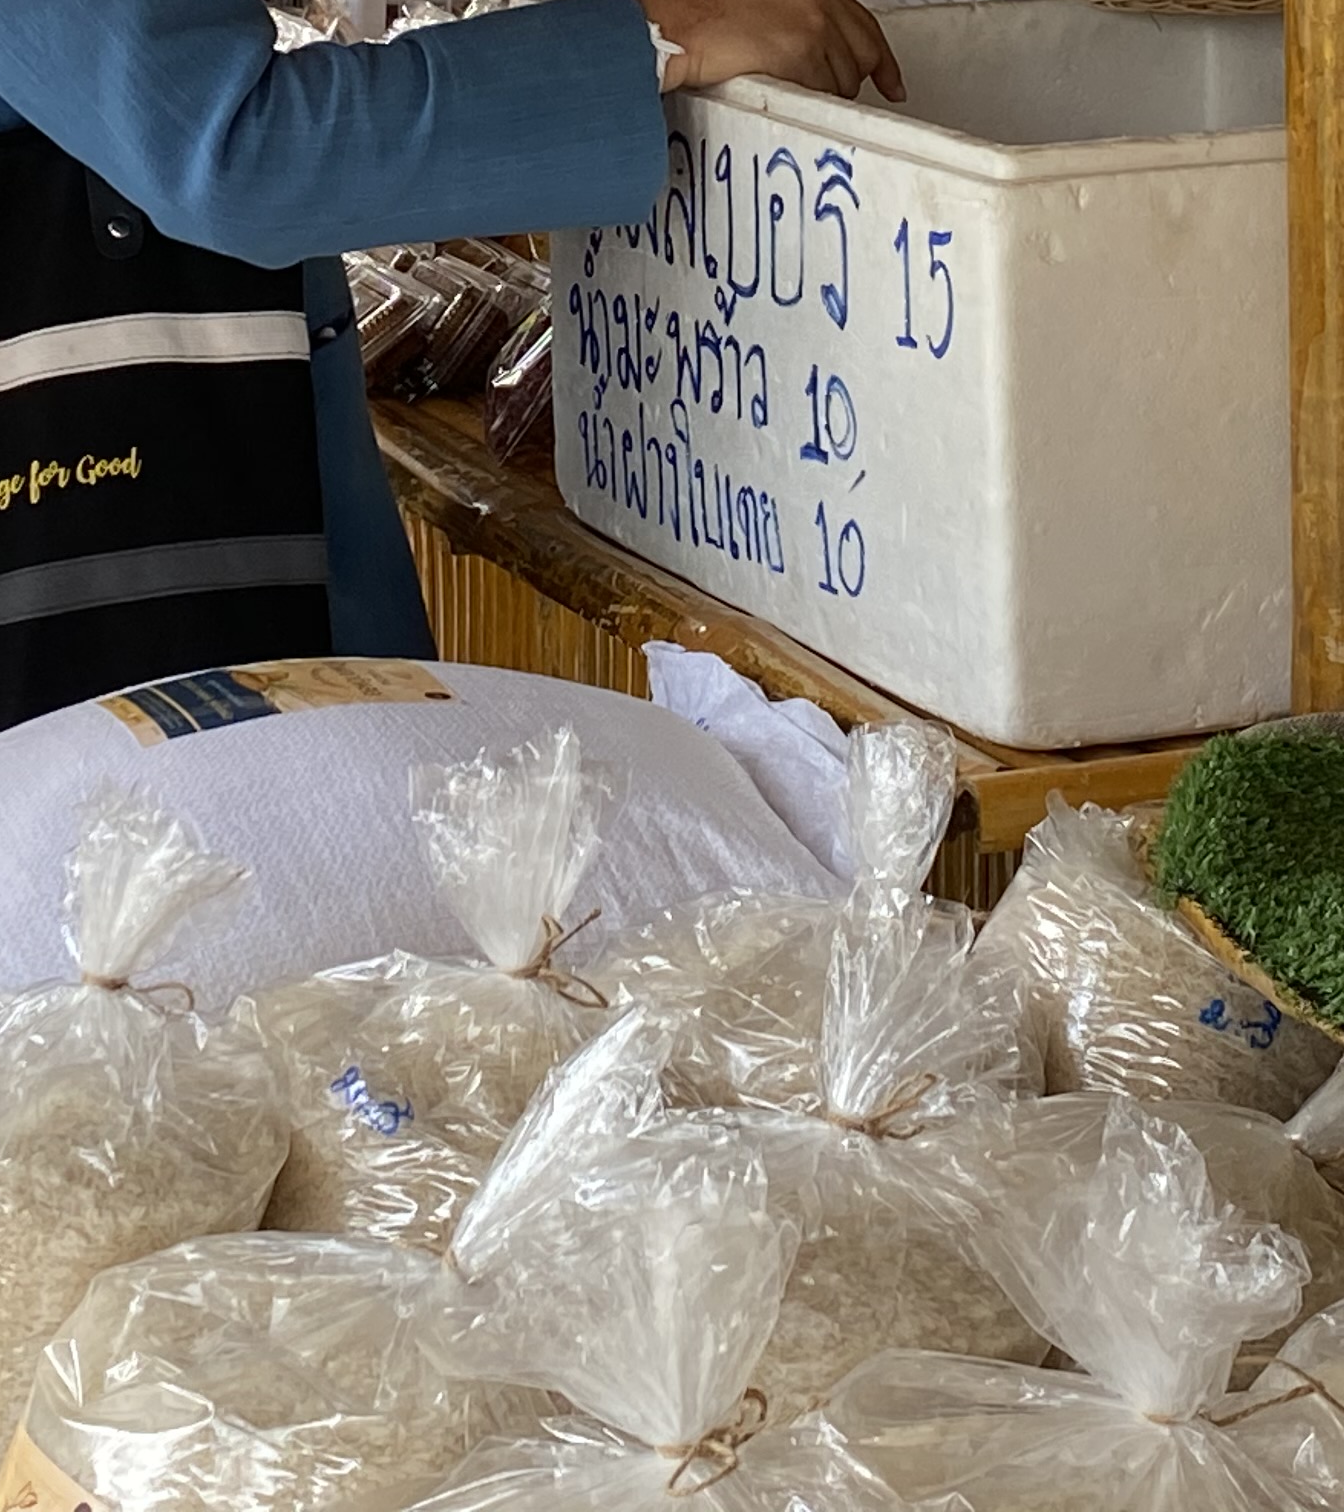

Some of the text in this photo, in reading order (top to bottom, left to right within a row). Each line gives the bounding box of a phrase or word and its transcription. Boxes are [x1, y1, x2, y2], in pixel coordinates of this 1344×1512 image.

[893, 217, 955, 358] 15
[799, 364, 858, 465] 10
[29, 460, 70, 505] for
[76, 446, 143, 486] Good
[814, 500, 866, 598] 10
